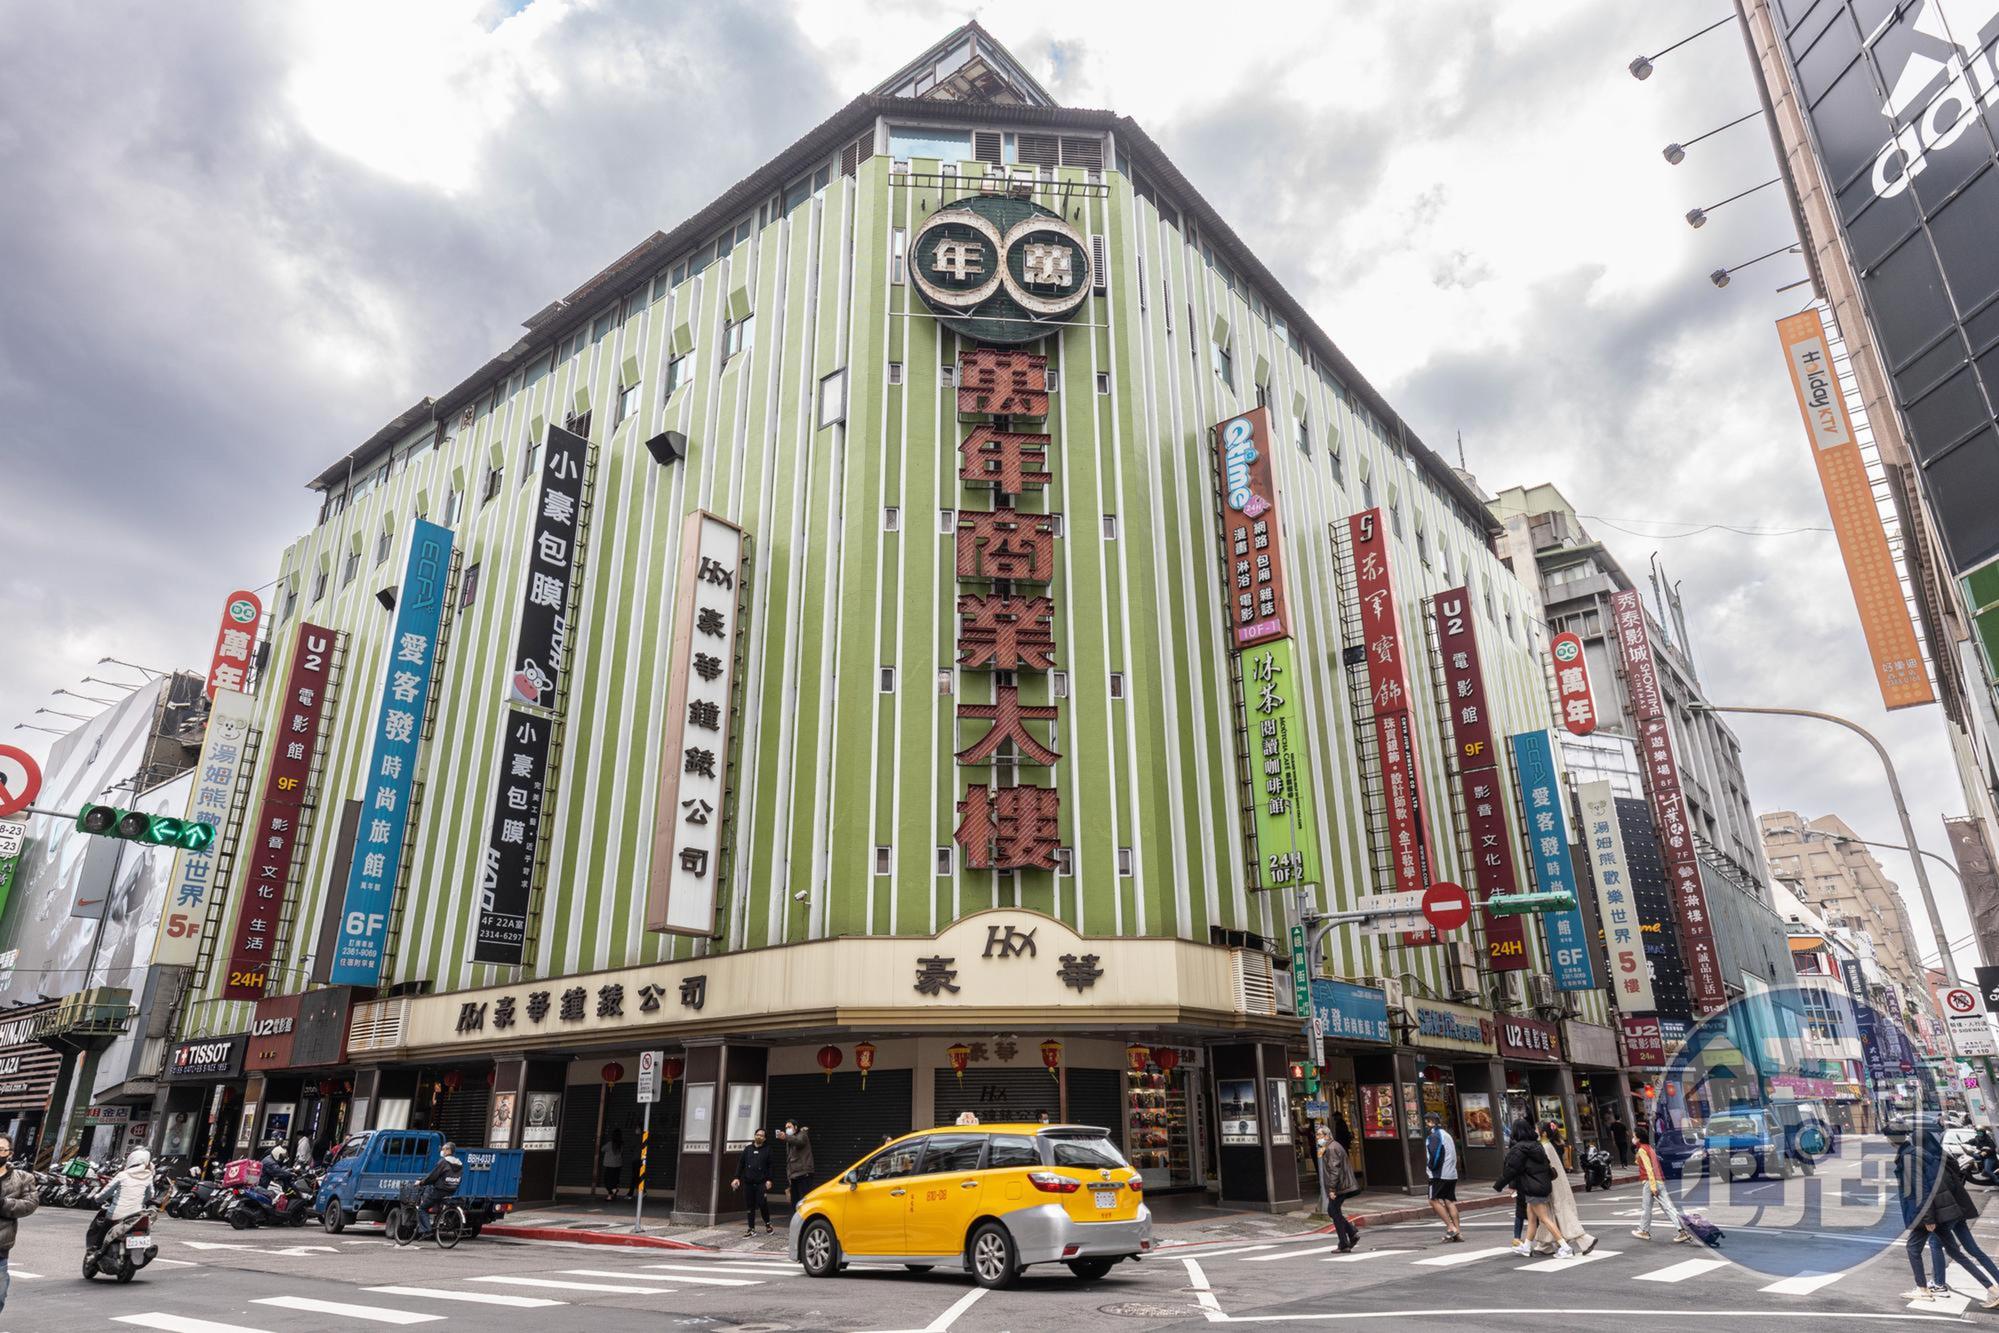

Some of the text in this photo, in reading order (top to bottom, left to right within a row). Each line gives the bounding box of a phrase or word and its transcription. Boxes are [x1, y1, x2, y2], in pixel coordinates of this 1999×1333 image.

[1872, 40, 1999, 198] adi
[932, 239, 985, 281] 年
[1802, 351, 1838, 433] Holiday KTV
[530, 450, 578, 611] 小豪包膜
[1253, 520, 1268, 549] 網路
[412, 539, 441, 611] ECFA
[1236, 560, 1251, 589] 淋浴
[954, 348, 1063, 869] 萬年商業大樓
[1239, 593, 1255, 623] 電影
[1259, 587, 1275, 617] 雜誌
[1617, 593, 1647, 663] 秀泰影城
[210, 628, 252, 692] 萬年
[1443, 600, 1485, 757] U2 電影館 9F
[1253, 651, 1285, 715] 沐茶
[1559, 667, 1593, 724] 萬年
[1634, 673, 1646, 709] CINEMAS
[1638, 663, 1662, 716] SHOWTIME
[277, 635, 327, 791] U2 電影館 9F
[362, 631, 428, 878] 愛客發時尚旅館
[679, 607, 726, 878] 豪華鐘錶公司
[1525, 737, 1547, 785] ECFA
[1651, 737, 1671, 776] 遊樂場
[501, 722, 537, 845] 小豪包膜
[1260, 718, 1286, 815] 閱讀咖啡館
[481, 846, 500, 912] HAO
[1532, 786, 1572, 936] 愛客發時尚館
[1593, 821, 1633, 944] 湯姆熊歡樂世界
[167, 913, 200, 939] 5F
[346, 911, 384, 936] 6F
[480, 930, 523, 941] 2314-6297
[481, 916, 525, 929] 4F 22A室
[1691, 927, 1704, 935] 5F
[1490, 941, 1523, 957] 24H
[1557, 948, 1583, 967] 6F
[230, 971, 265, 987] 24H
[914, 953, 1104, 995] 豪 華
[1698, 952, 1716, 994] 誠品生活
[494, 974, 707, 1028] 豪華鐘錶公司
[1377, 1020, 1387, 1038] 6F
[1506, 1024, 1524, 1047] U2
[1624, 1026, 1659, 1037] U2
[1627, 1038, 1661, 1050] 電影館
[189, 1042, 231, 1065] TISSOT
